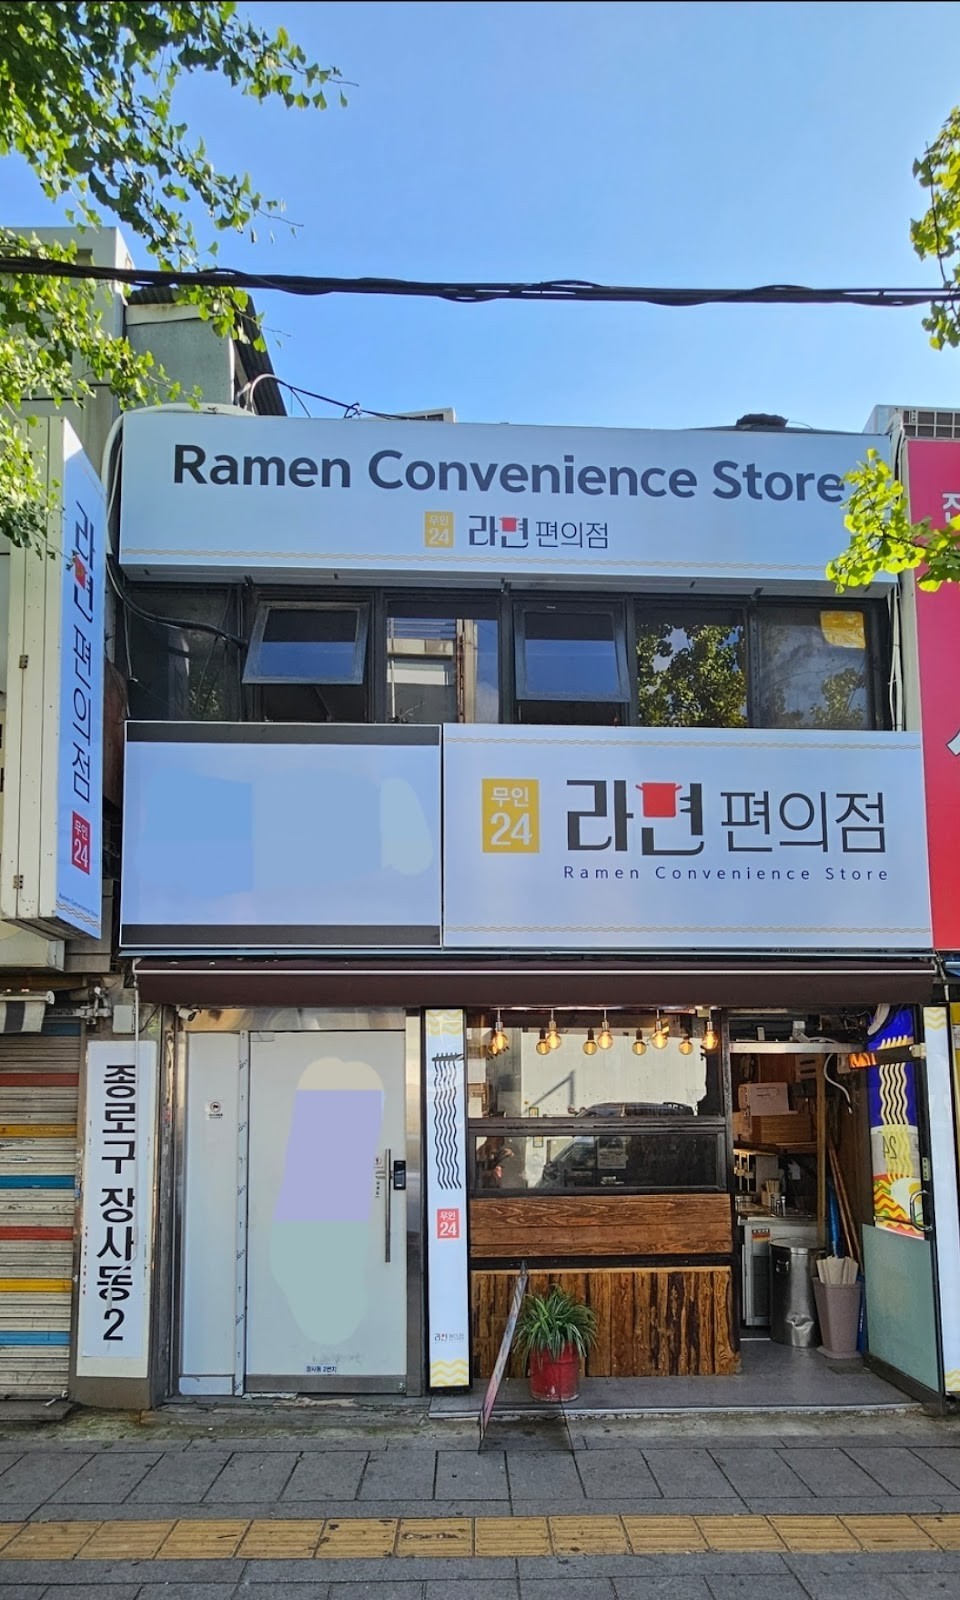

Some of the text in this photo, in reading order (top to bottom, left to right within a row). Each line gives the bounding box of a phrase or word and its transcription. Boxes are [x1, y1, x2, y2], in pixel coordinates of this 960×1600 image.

[173, 443, 845, 502] Ramen Convenience Store
[429, 514, 449, 526] 무인
[468, 515, 608, 549] 라면 편의점
[428, 528, 449, 545] 24
[72, 624, 91, 803] 편의점
[491, 785, 530, 808] 무인
[490, 812, 532, 846] 24
[566, 779, 886, 856] 라면 편의점
[74, 838, 89, 868] 24
[564, 865, 888, 881] Ramen Convenience Store
[96, 1064, 136, 1341] 종로구 장사동 2
[440, 1221, 457, 1236] 24
